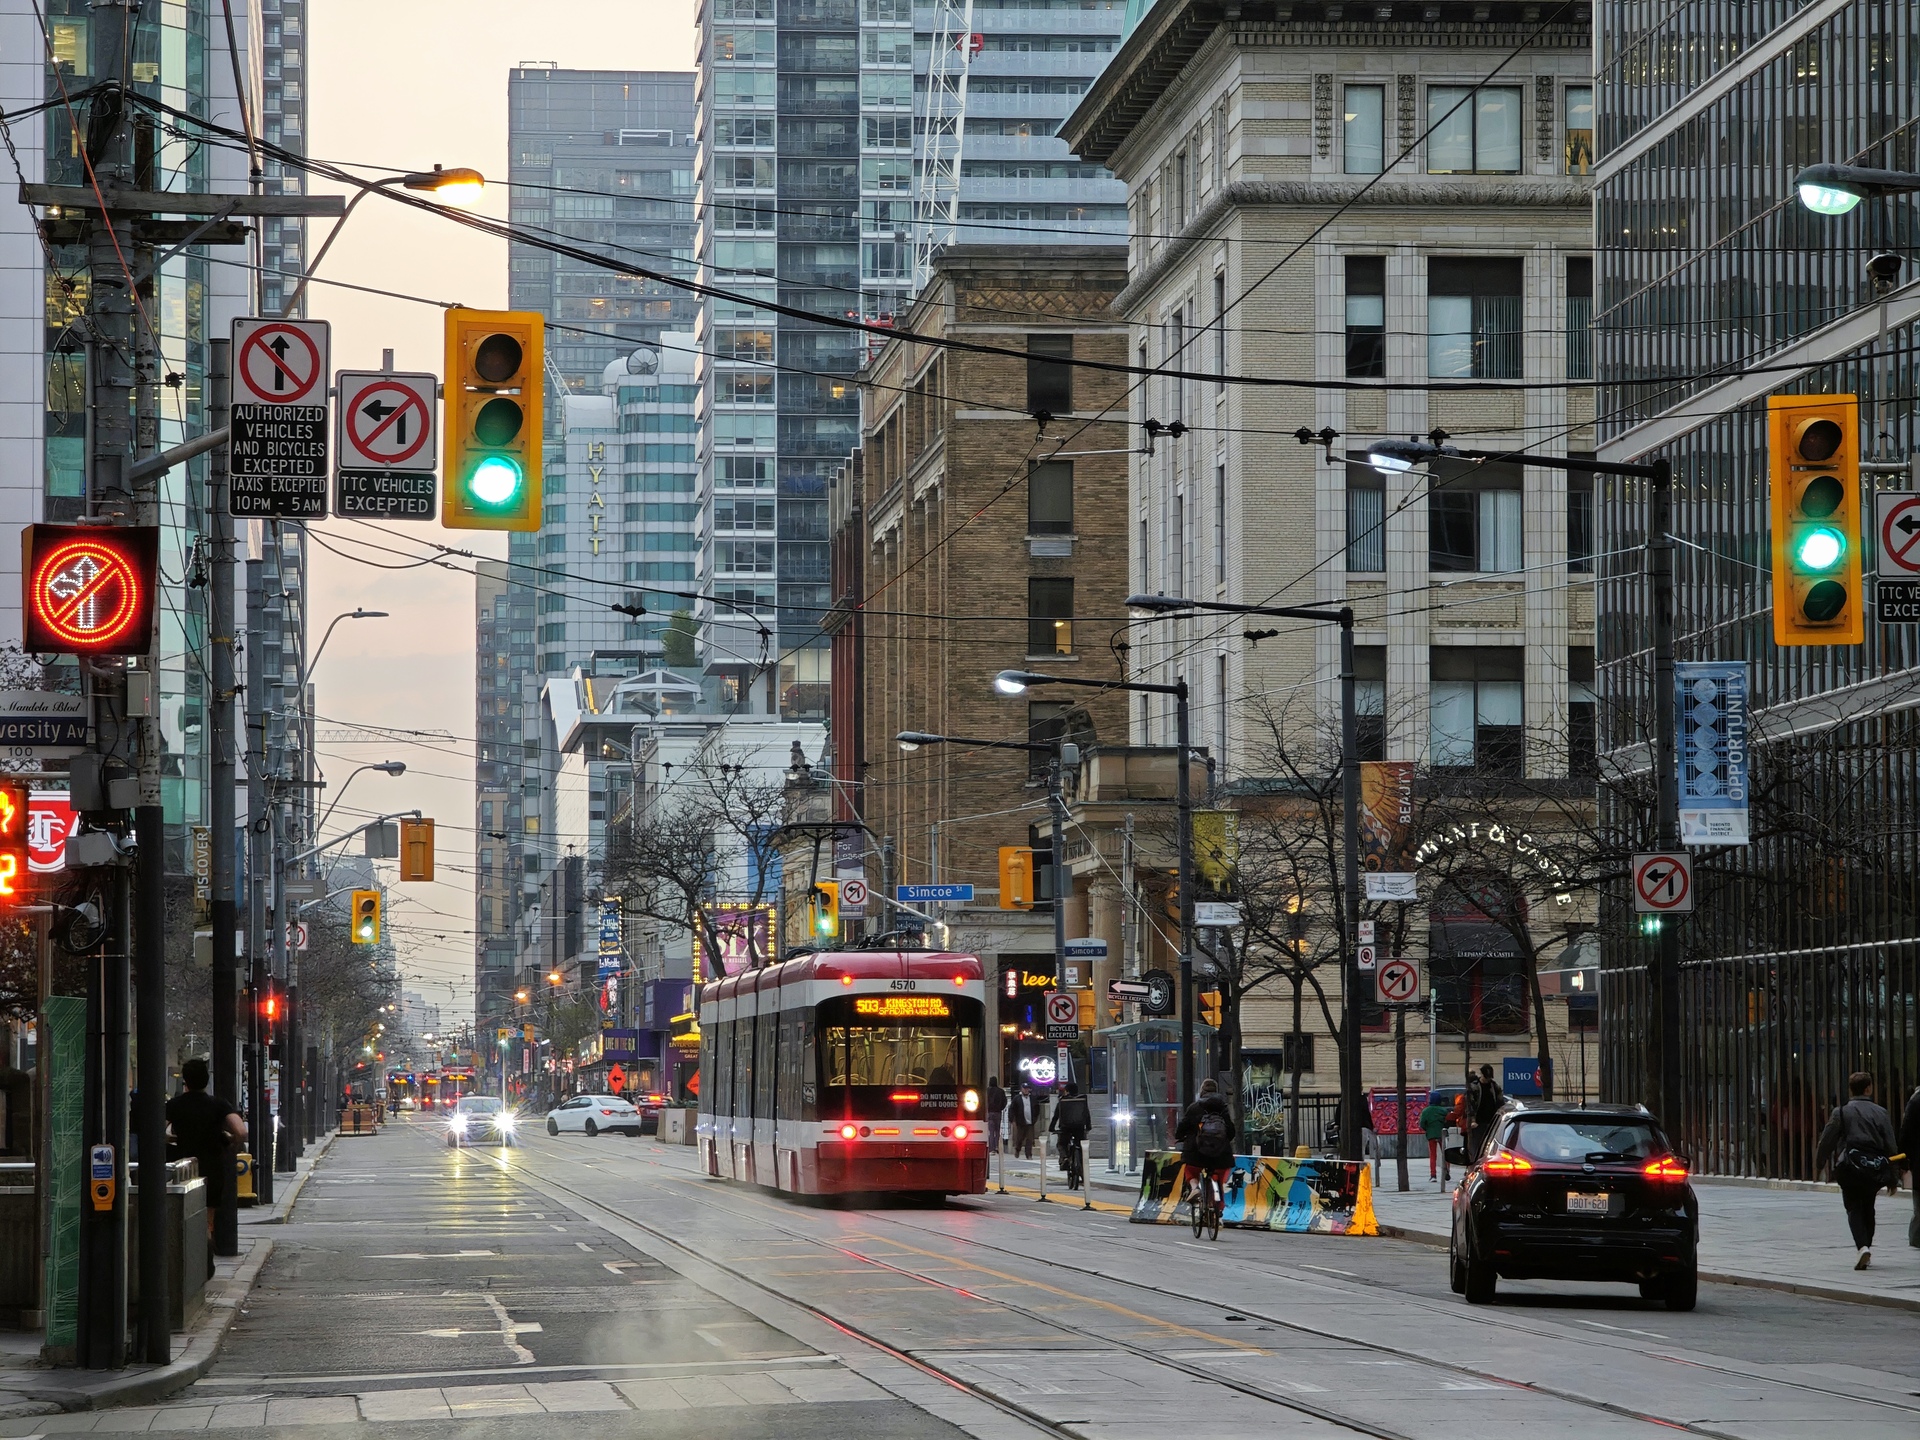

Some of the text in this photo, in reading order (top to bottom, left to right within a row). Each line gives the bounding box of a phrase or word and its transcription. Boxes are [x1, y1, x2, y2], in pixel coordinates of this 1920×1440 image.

[235, 406, 324, 422] AUTHORIZED
[246, 424, 313, 439] VEHICLES
[233, 441, 325, 458] AND BICYCLES
[243, 458, 315, 475] EXCEPTED
[231, 477, 326, 494] TAXIS EXCEPTED
[341, 476, 434, 495] TTC VEHICLES
[236, 495, 250, 510] 10
[253, 497, 271, 511] PM
[303, 499, 321, 512] AM
[344, 495, 429, 513] EXCEPTED
[587, 441, 604, 556] HYATT
[1880, 586, 1903, 600] TTC
[3, 700, 49, 712] Mandela
[67, 724, 85, 739] Av
[1727, 671, 1744, 801] OPPORTUNITY
[8, 746, 33, 757] 100
[1398, 768, 1412, 824] BEAUTY
[1488, 823, 1506, 844] &
[837, 842, 852, 850] For
[908, 886, 952, 898] Simcoe
[1071, 947, 1094, 955] Simcoe
[890, 980, 916, 990] 4570
[1022, 970, 1050, 986] lee
[856, 999, 879, 1013] 503
[886, 998, 942, 1008] KINGSTON RD
[1129, 995, 1150, 1003] EXCEPTED
[879, 1007, 949, 1015] SPADINA via KING
[1507, 1072, 1531, 1081] BMO
